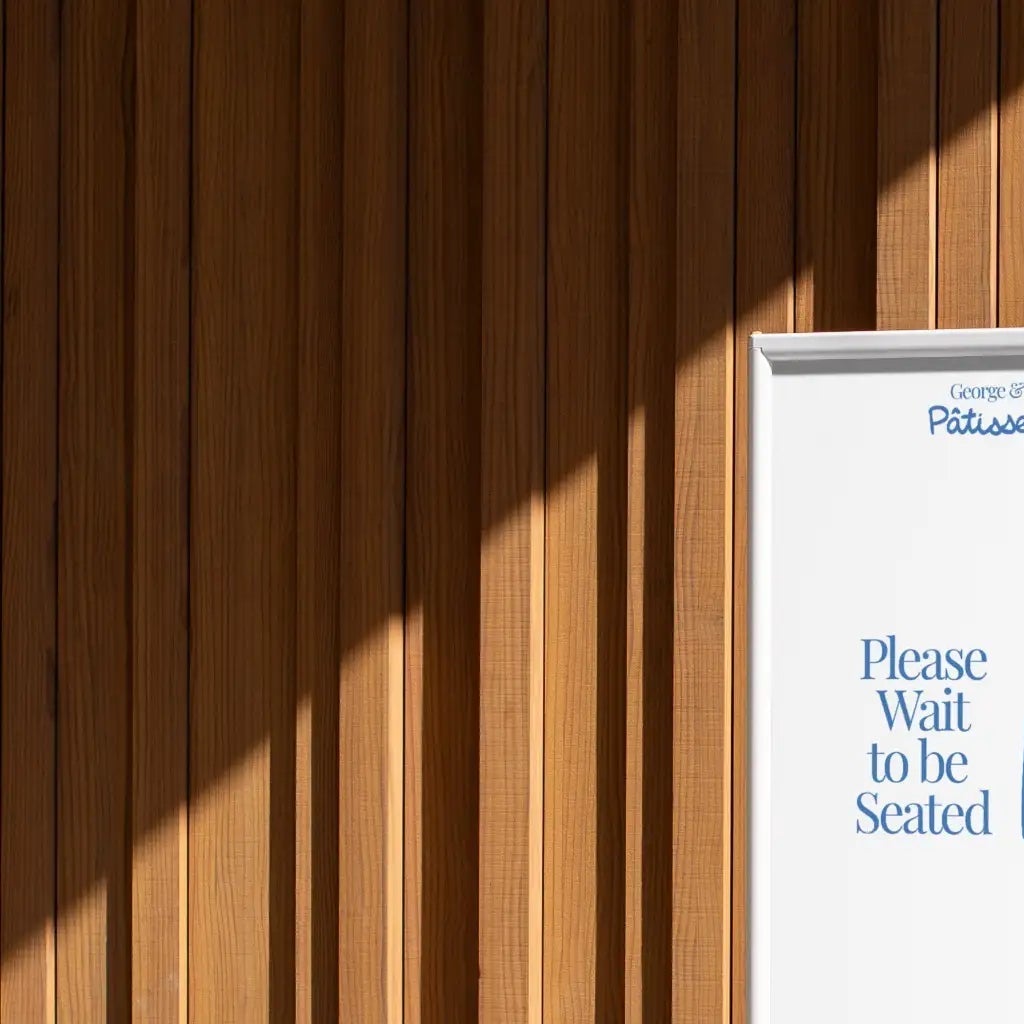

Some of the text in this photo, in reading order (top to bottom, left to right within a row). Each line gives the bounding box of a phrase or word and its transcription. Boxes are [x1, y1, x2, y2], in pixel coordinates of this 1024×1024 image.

[950, 383, 1006, 402] George
[1009, 382, 1024, 398] &
[860, 634, 988, 681] Please
[876, 687, 972, 733] Wait
[867, 737, 968, 784] to be
[856, 789, 993, 836] Seated
